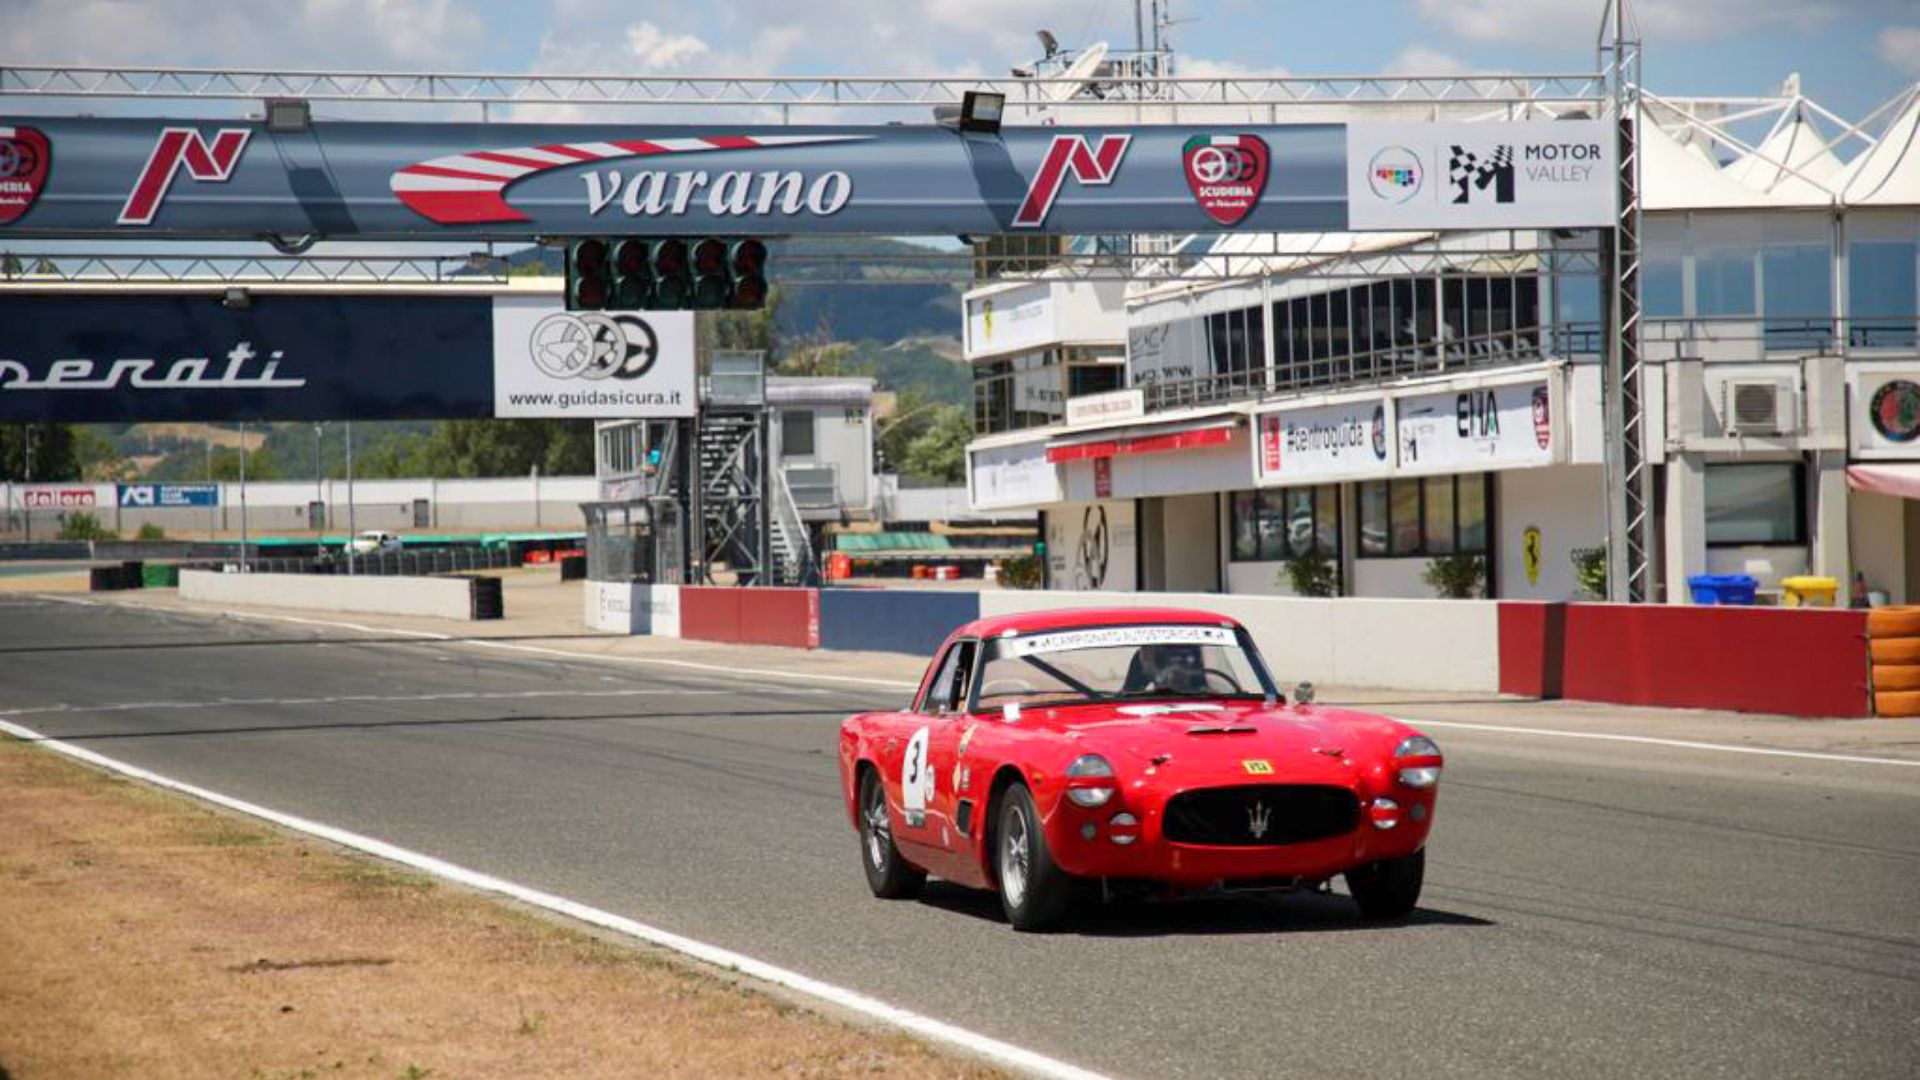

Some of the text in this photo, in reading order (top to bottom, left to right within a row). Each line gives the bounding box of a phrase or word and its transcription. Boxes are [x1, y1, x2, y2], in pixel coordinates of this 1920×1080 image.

[1525, 143, 1601, 160] MOTOR
[1527, 164, 1593, 182] VALLEY
[580, 169, 852, 216] varano
[1199, 186, 1253, 197] SCUDERIA
[509, 389, 682, 409] www.guidasicura.it
[909, 740, 920, 783] 3
